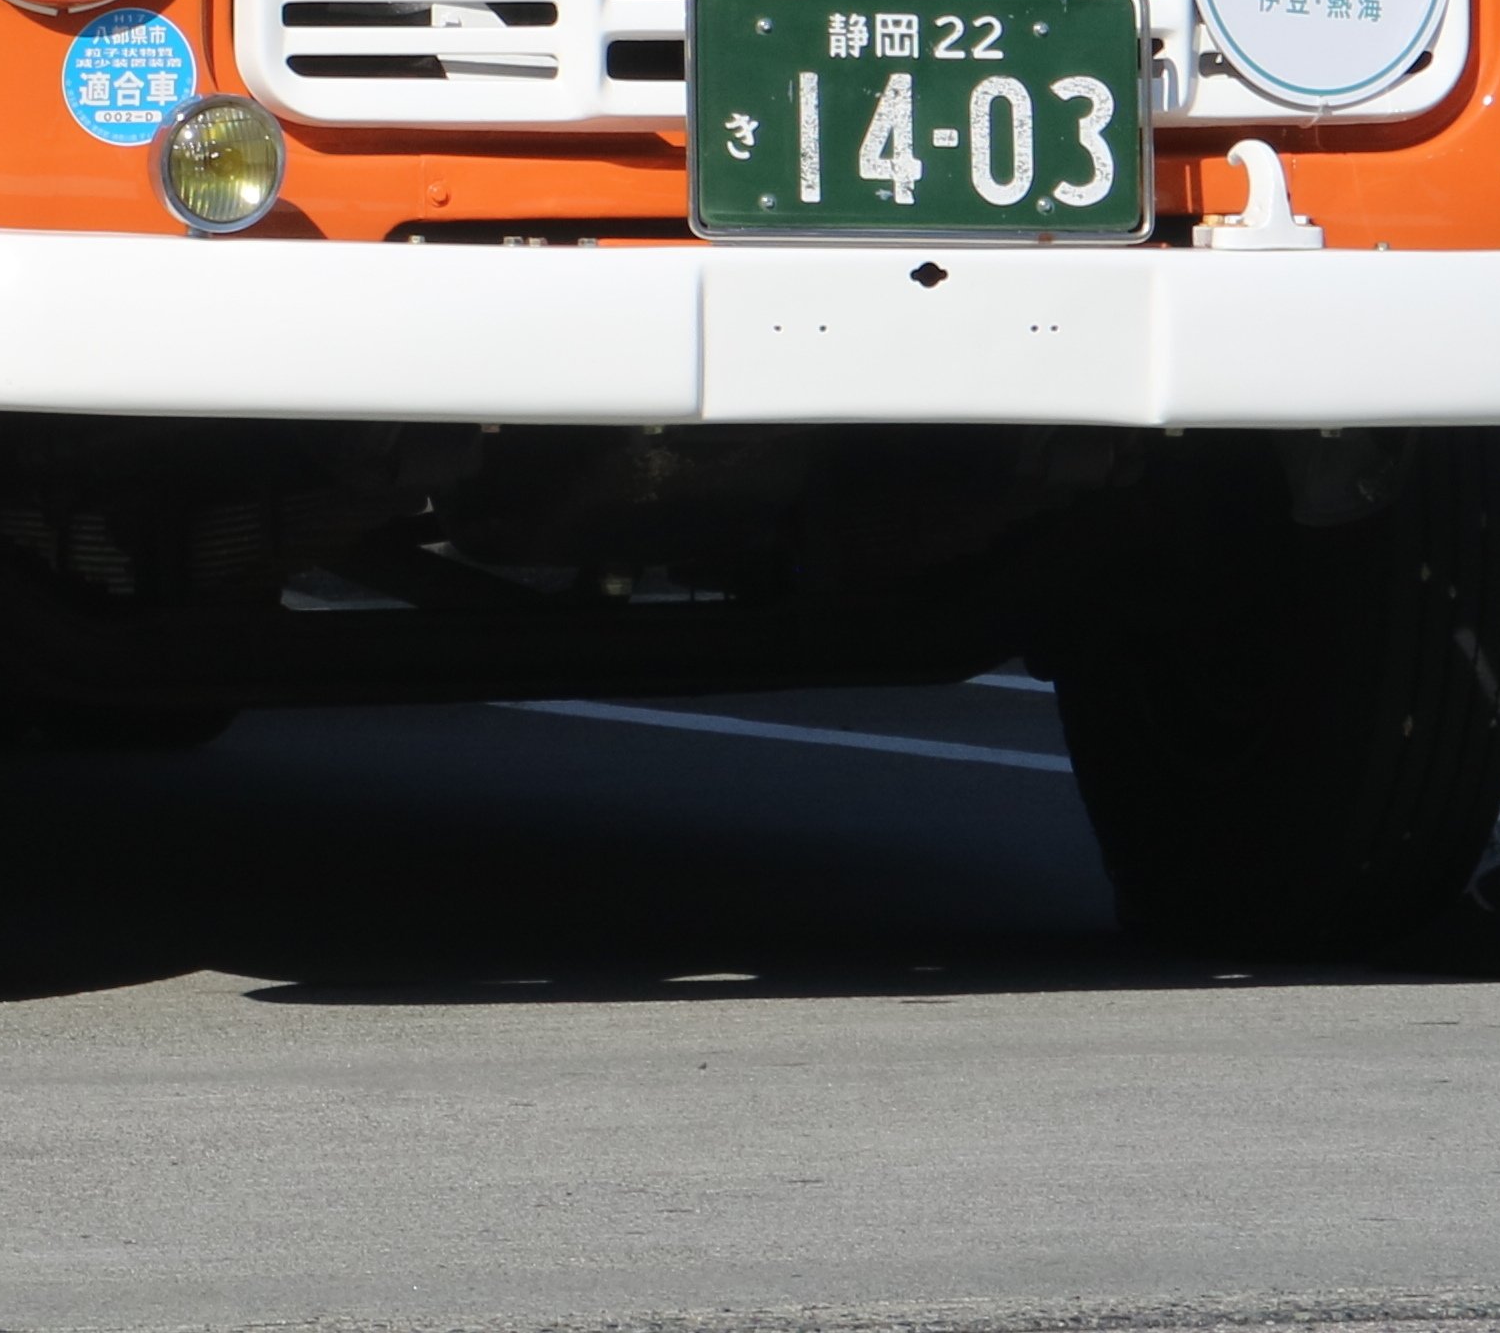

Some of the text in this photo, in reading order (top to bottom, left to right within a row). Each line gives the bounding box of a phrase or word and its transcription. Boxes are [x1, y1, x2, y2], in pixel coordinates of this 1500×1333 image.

[113, 14, 146, 23] H17
[92, 25, 167, 45] 八都県市
[85, 47, 174, 58] 粒子状物質
[79, 71, 179, 107] 適合車
[103, 112, 154, 122] 002-D
[724, 71, 1116, 208] き 14-03
